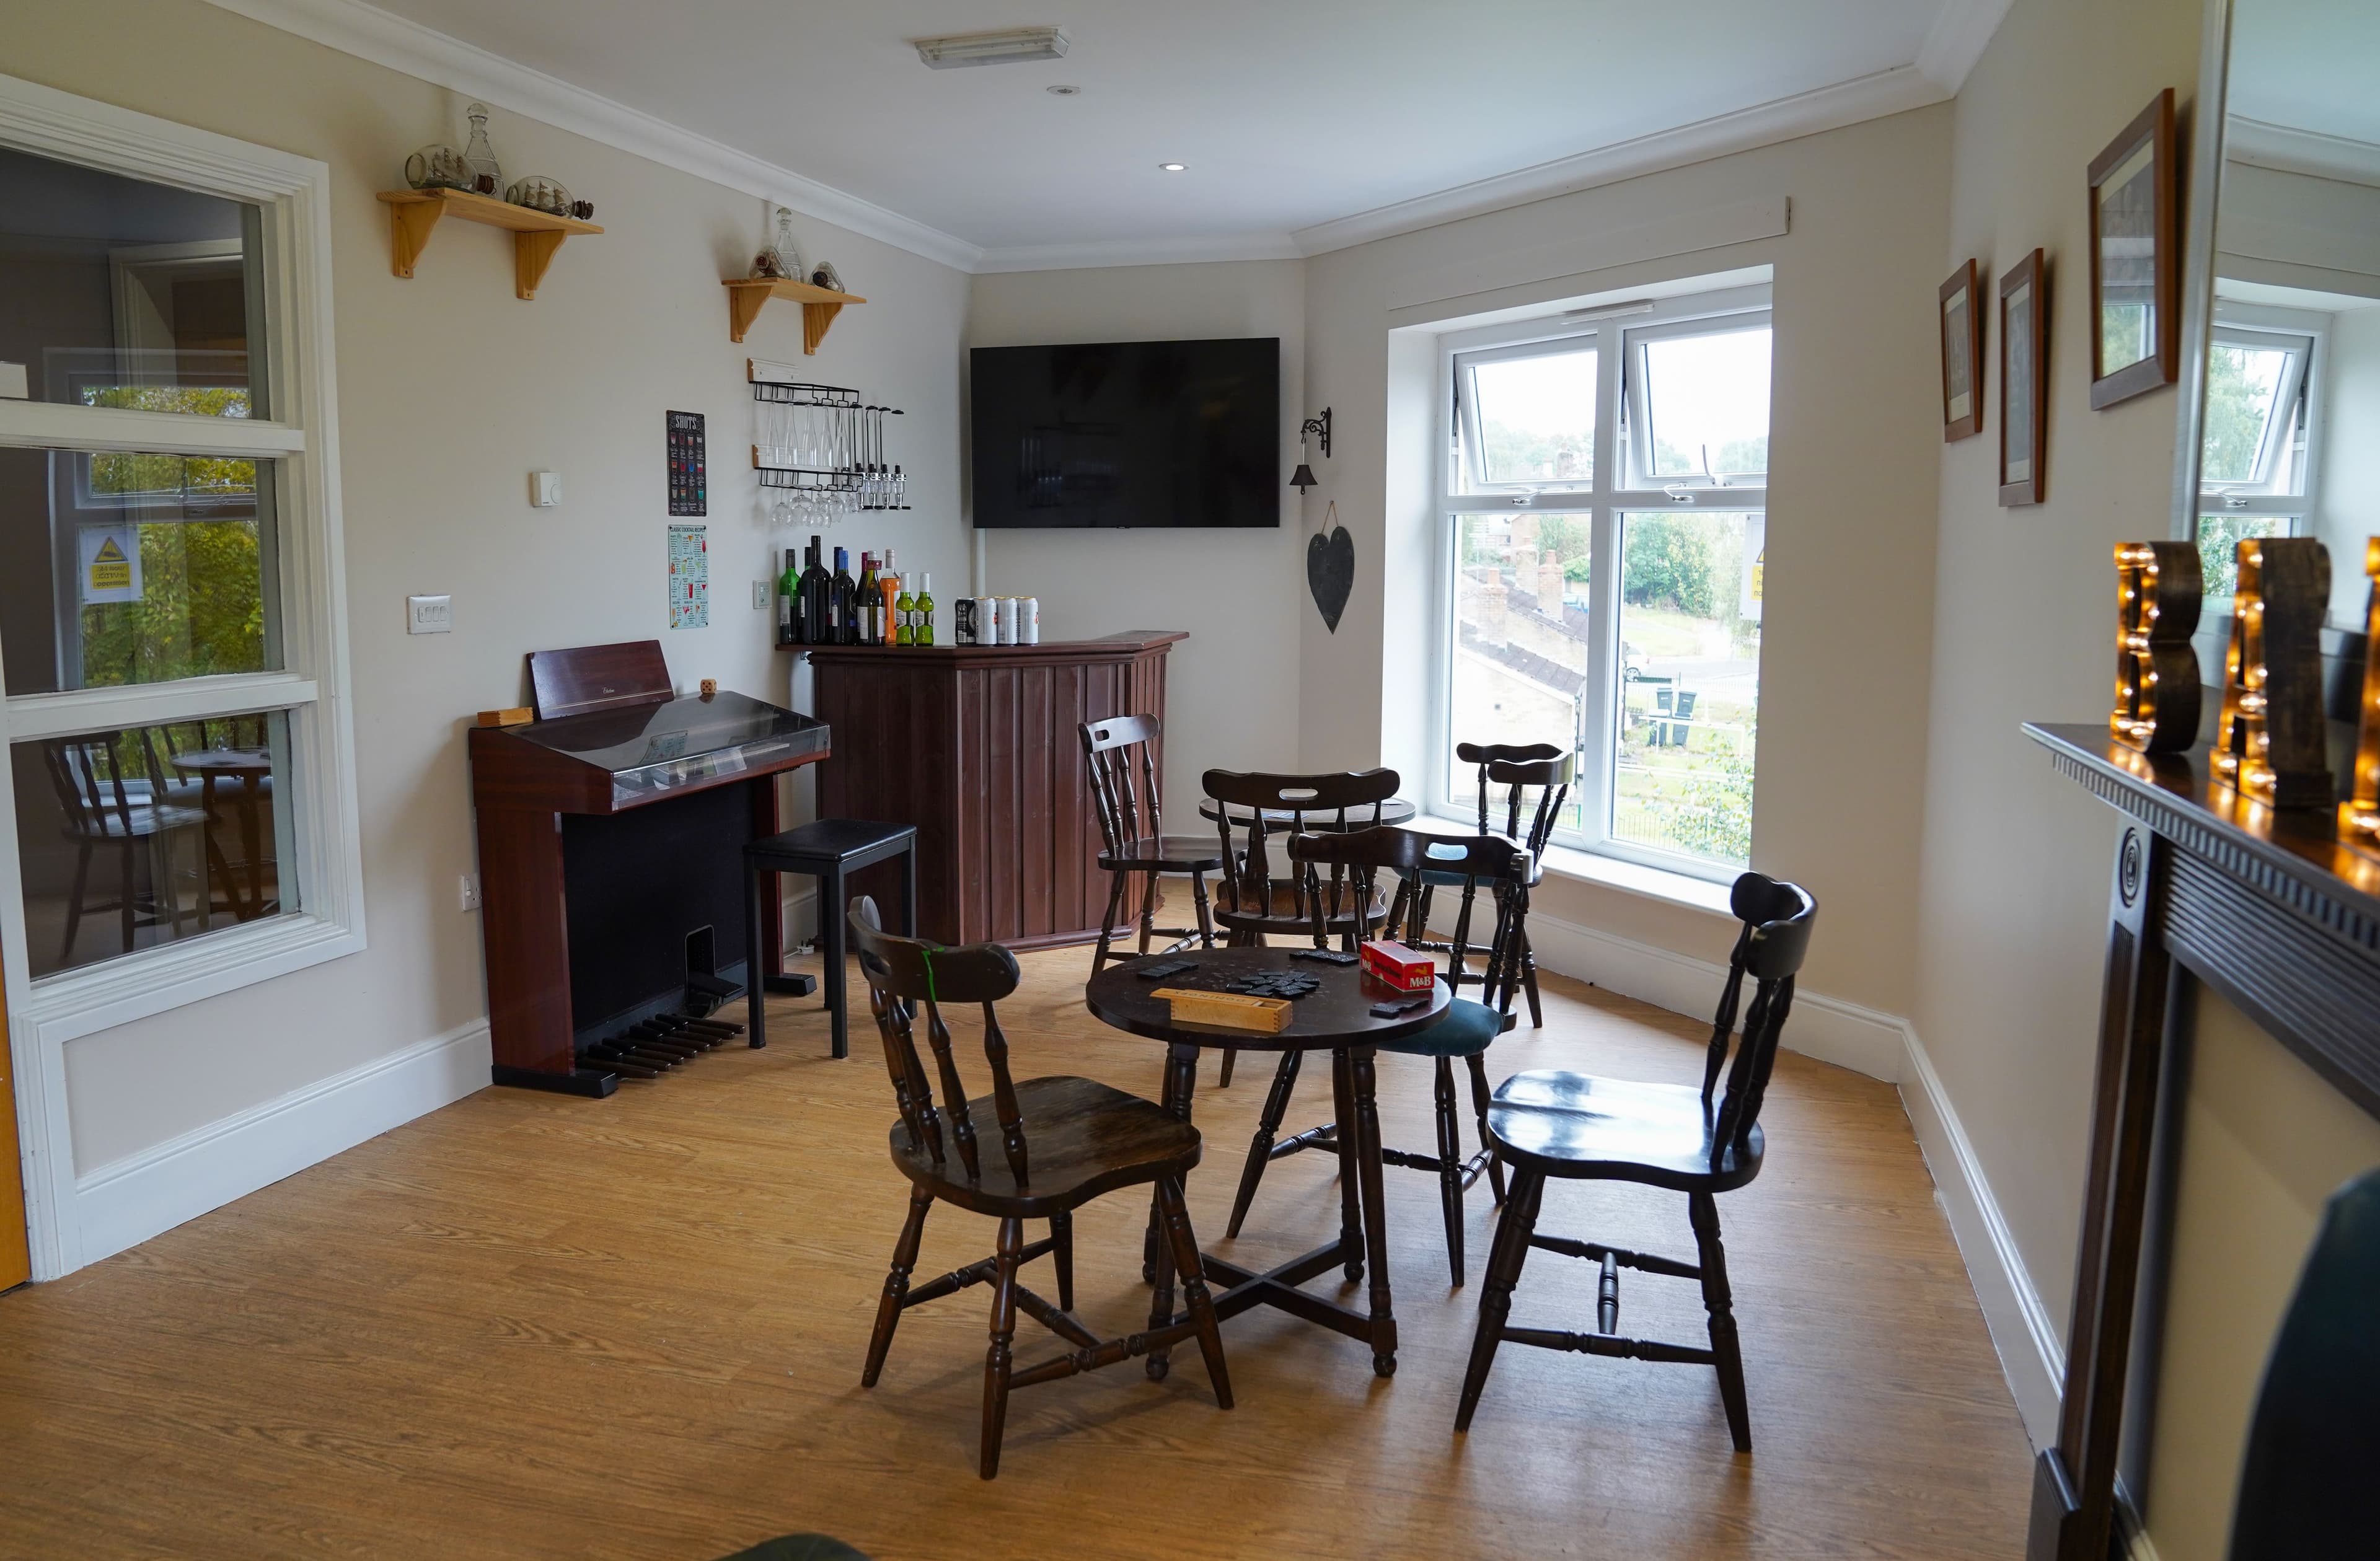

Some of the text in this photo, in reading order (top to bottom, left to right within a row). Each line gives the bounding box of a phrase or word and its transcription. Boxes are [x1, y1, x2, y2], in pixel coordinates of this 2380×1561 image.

[676, 415, 697, 430] SHOTS
[1362, 959, 1372, 972] M&B
[1409, 976, 1431, 988] M&B
